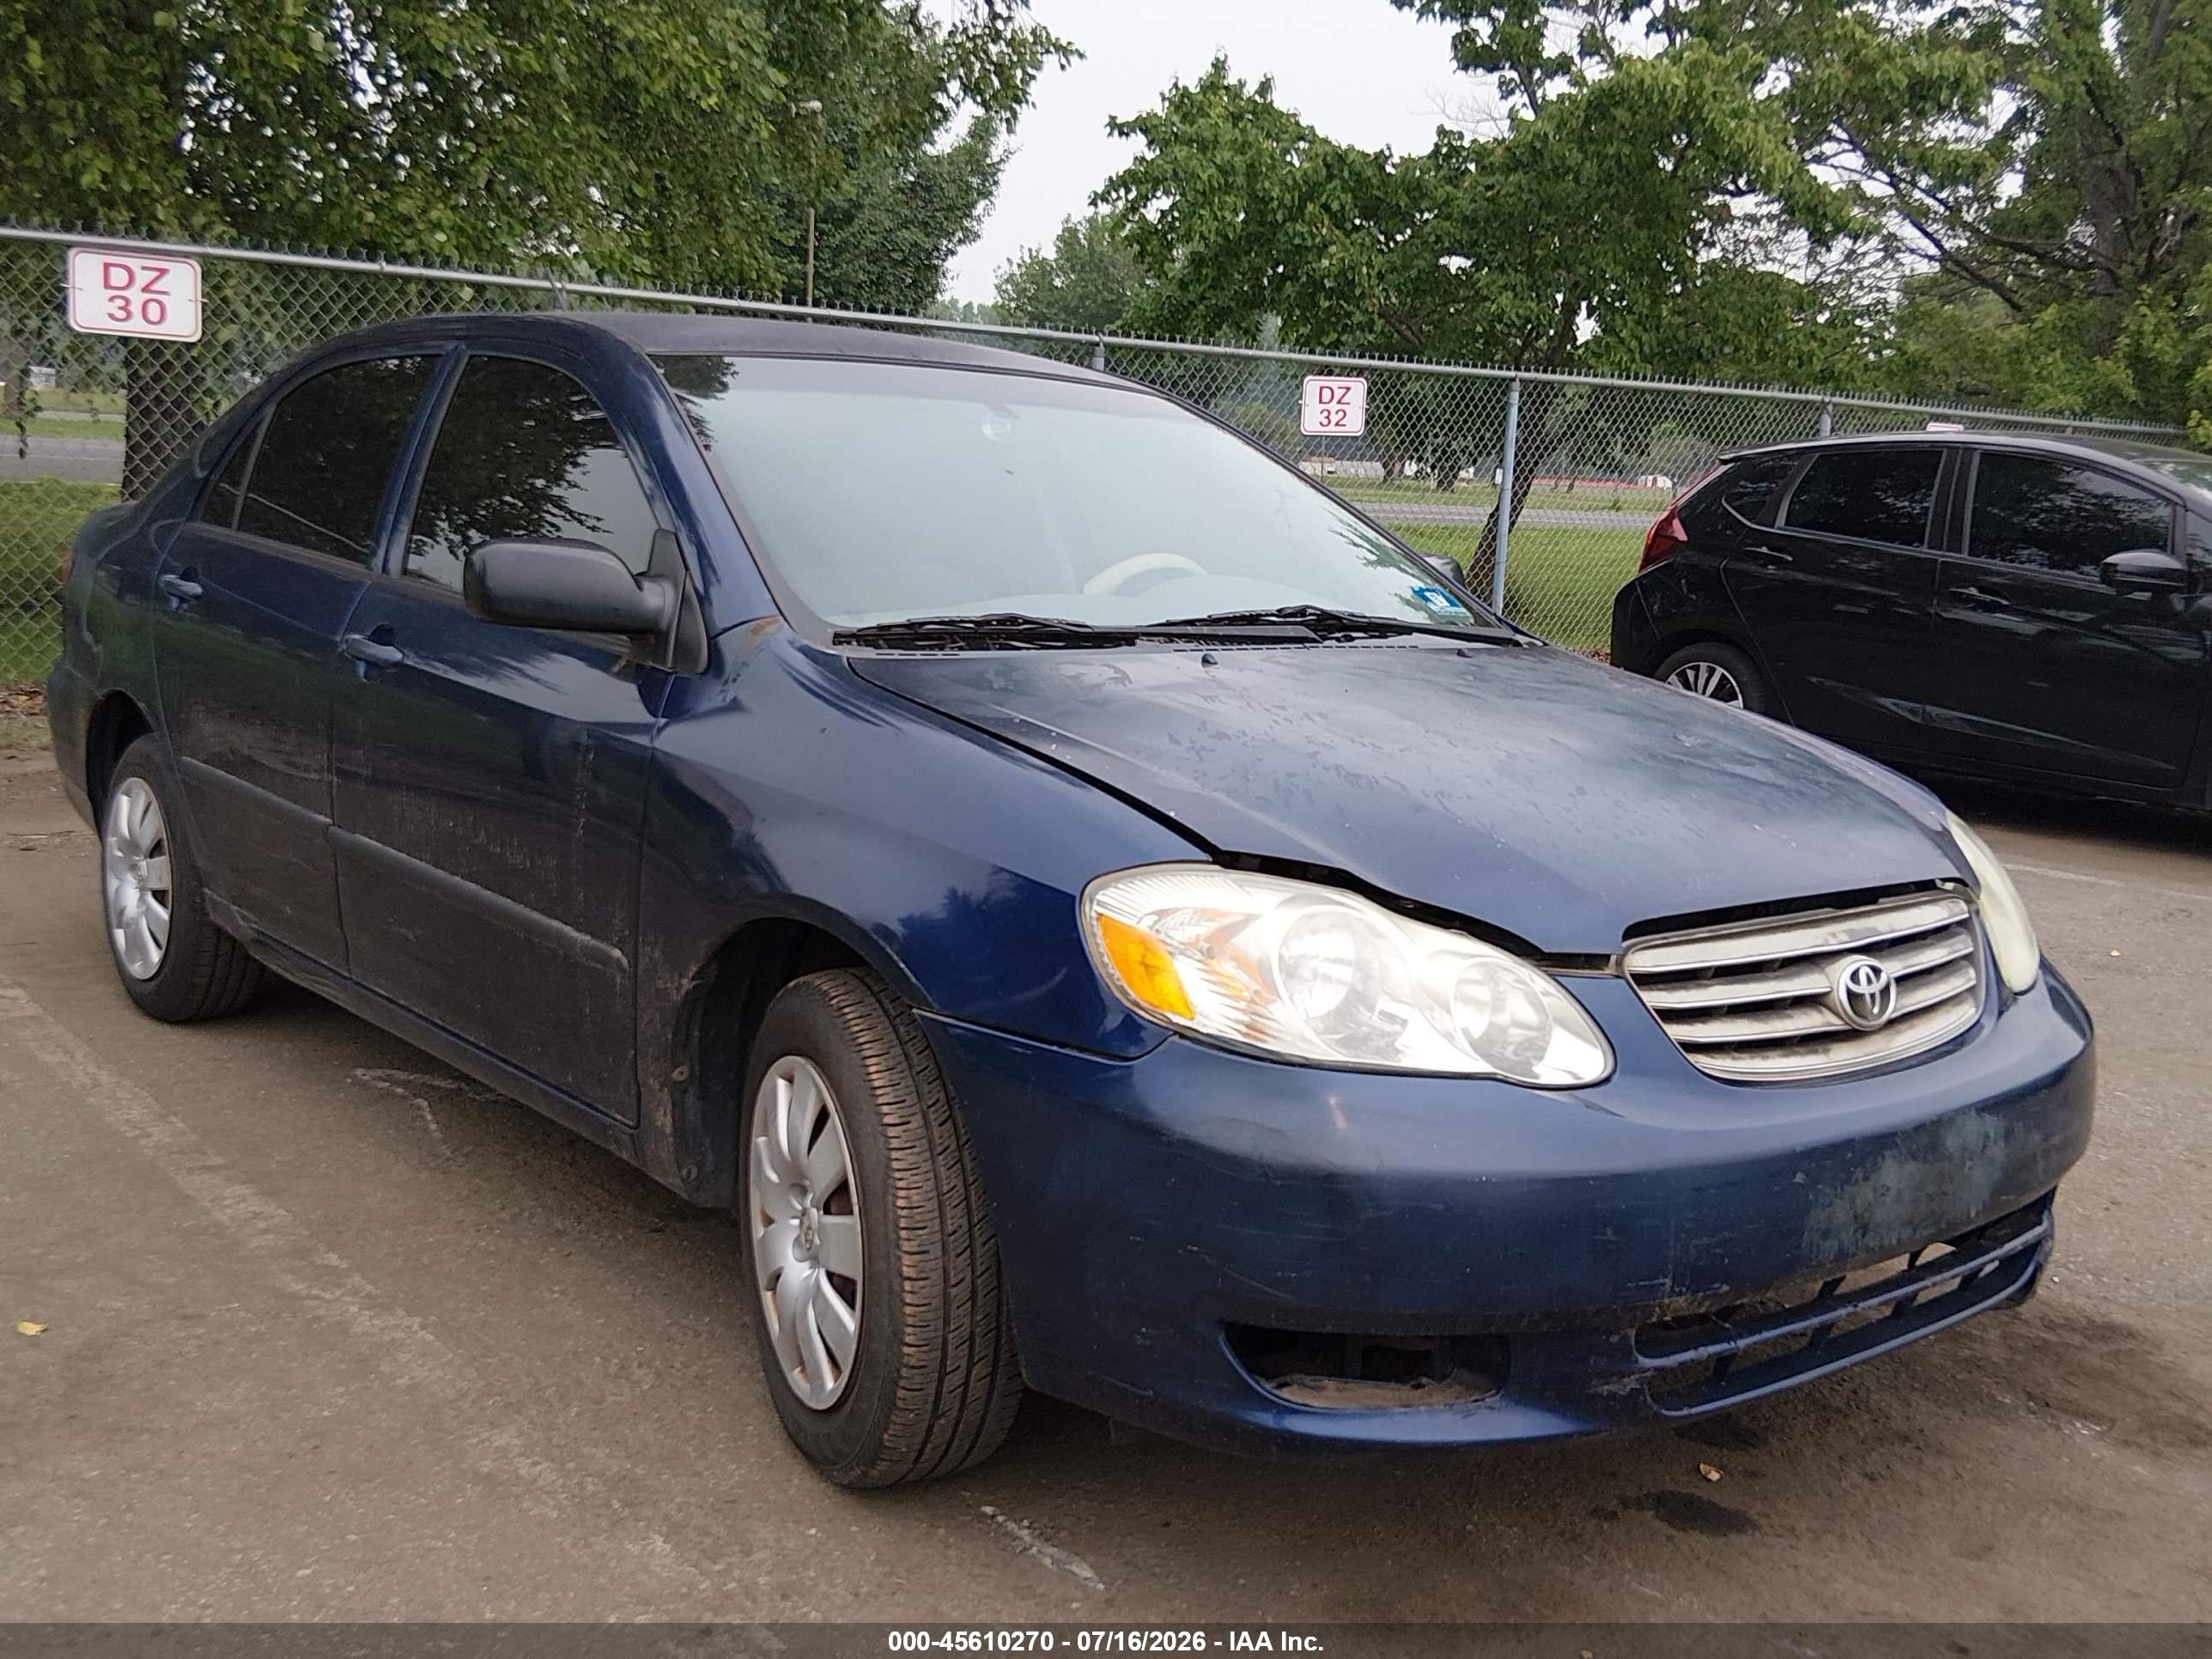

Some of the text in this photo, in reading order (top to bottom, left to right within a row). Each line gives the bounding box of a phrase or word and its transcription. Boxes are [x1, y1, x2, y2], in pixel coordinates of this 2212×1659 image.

[103, 261, 171, 296] DZ
[107, 295, 167, 326] 30
[1318, 385, 1352, 405] DZ
[1318, 408, 1347, 428] 32
